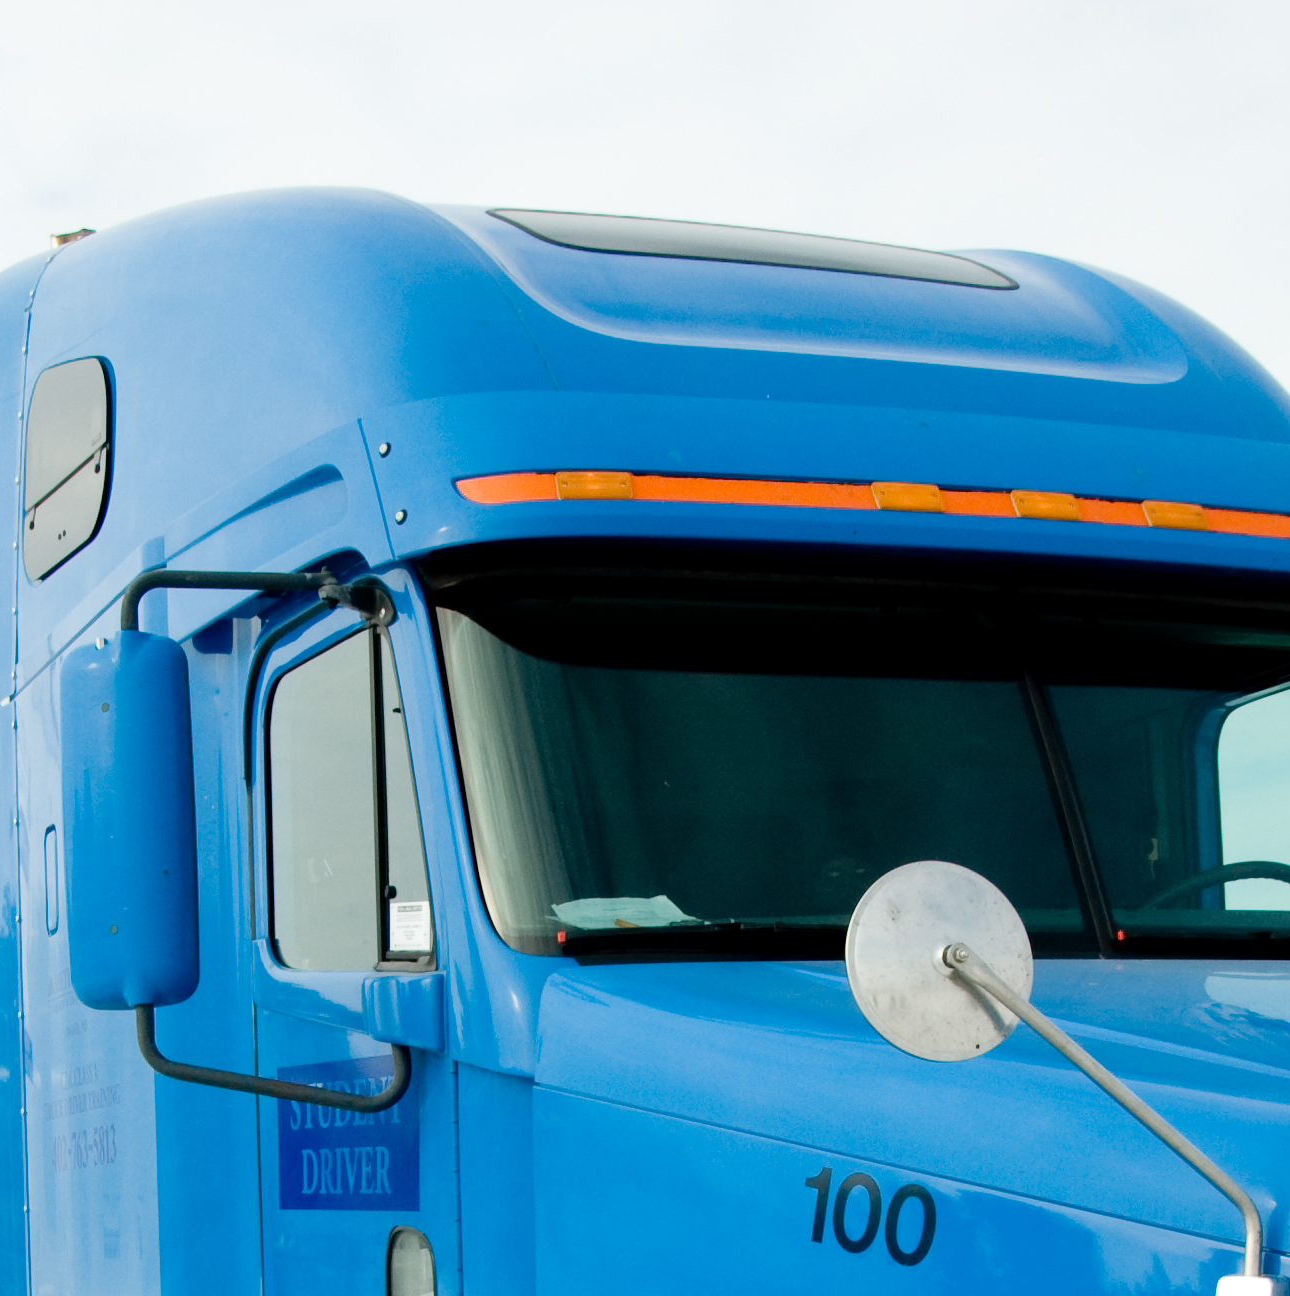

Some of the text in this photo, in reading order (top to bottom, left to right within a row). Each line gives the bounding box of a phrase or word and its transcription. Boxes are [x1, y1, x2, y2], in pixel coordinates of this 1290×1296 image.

[290, 1075, 401, 1130] STUDENT
[301, 1146, 393, 1195] DRIVER
[804, 1166, 937, 1267] 100
